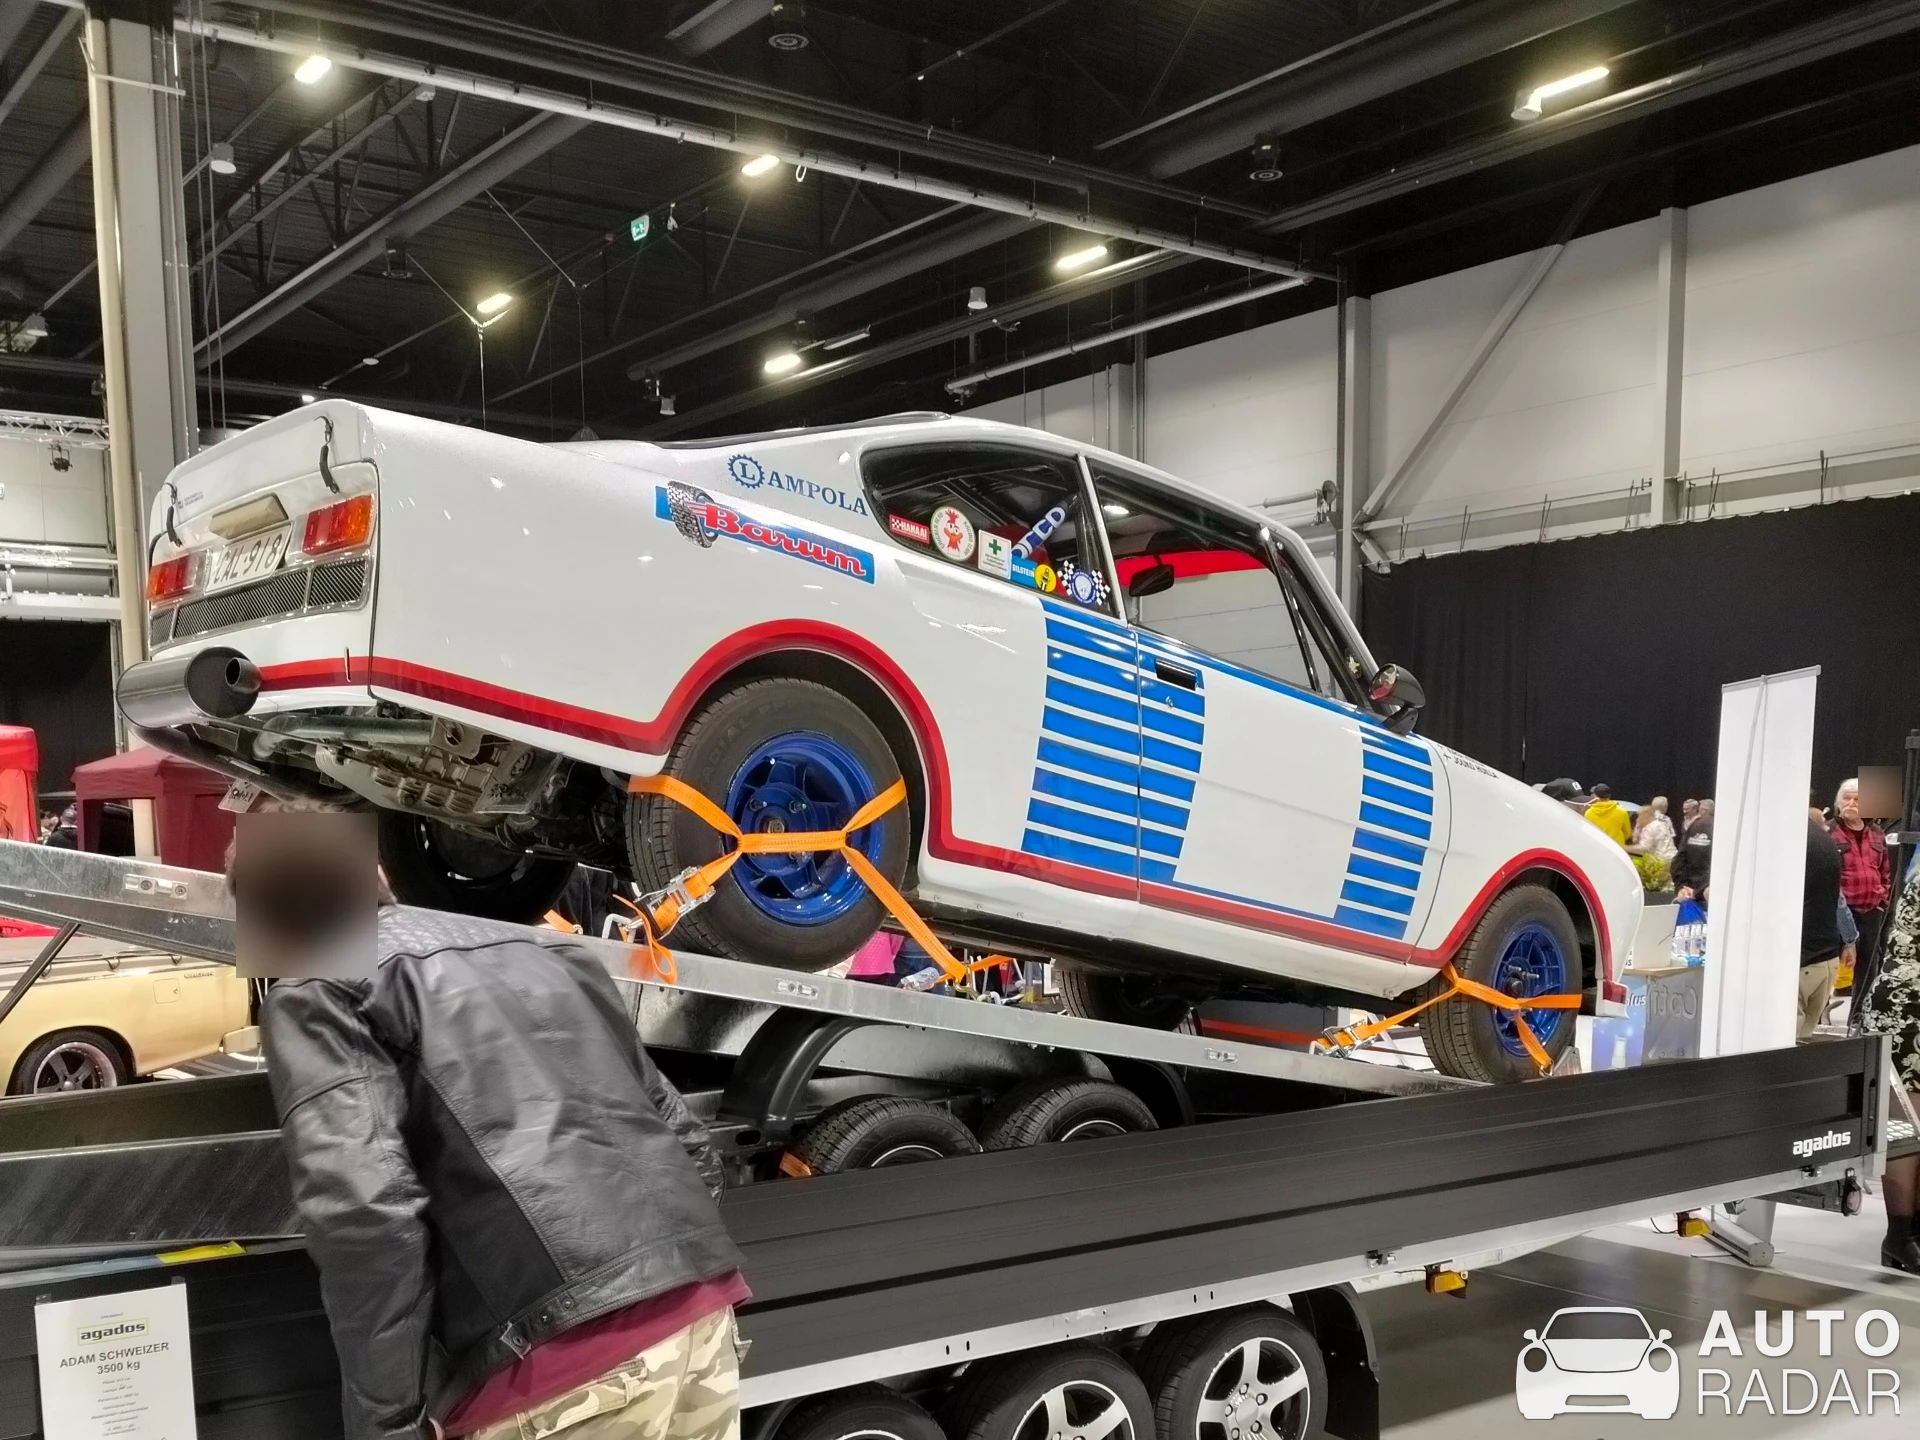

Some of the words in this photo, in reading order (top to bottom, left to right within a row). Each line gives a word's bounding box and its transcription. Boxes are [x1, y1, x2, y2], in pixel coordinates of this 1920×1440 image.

[703, 502, 867, 577] Barum
[1792, 1130, 1851, 1158] agados
[80, 1322, 146, 1341] agados
[59, 1353, 96, 1368] ADAM
[98, 1341, 169, 1361] SCHWEIZER
[96, 1362, 124, 1375] 3500
[126, 1360, 141, 1371] kg
